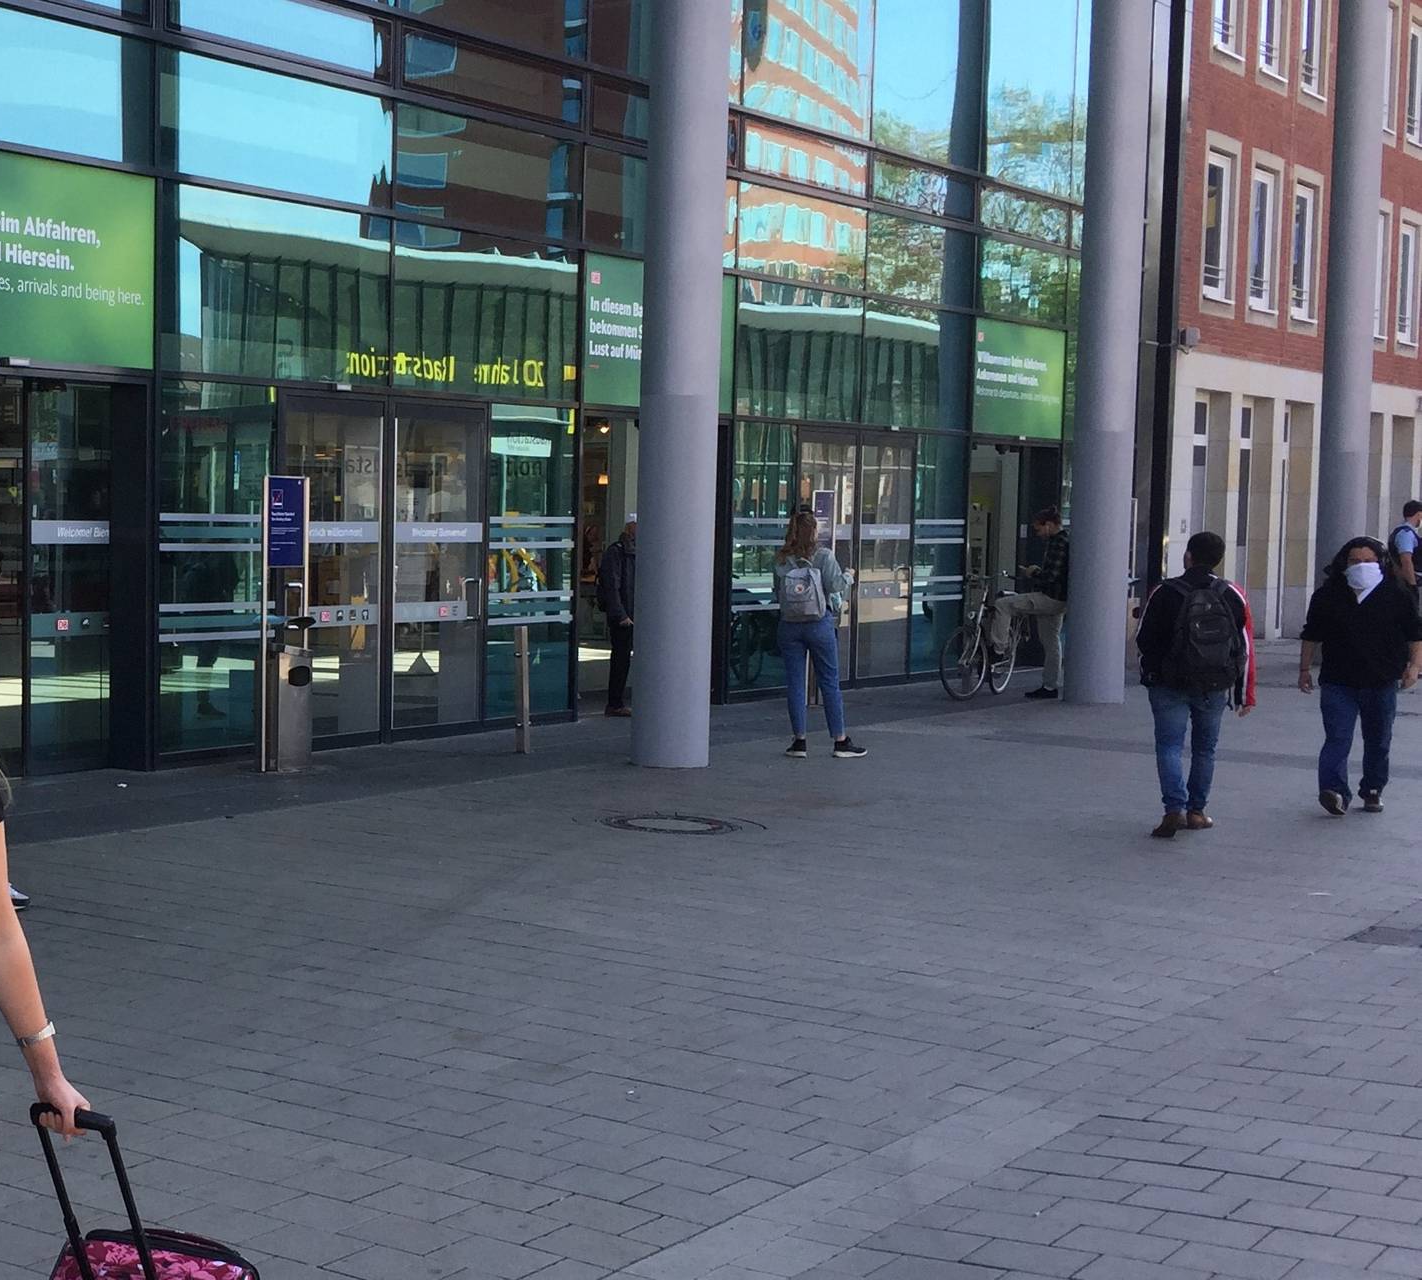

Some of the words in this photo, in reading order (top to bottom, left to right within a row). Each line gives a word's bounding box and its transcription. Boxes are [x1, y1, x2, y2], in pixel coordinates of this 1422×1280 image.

[24, 216, 101, 248] Abfahren,
[5, 243, 75, 270] Hiersein.
[17, 277, 58, 297] arrivals
[61, 282, 82, 299] and
[85, 283, 116, 306] being
[118, 287, 145, 305] here.
[590, 296, 600, 311] In
[601, 298, 631, 316] diesem
[589, 318, 637, 338] bekommen
[589, 340, 609, 357] Lust
[610, 343, 624, 358] auf
[58, 527, 92, 538] Welcome!
